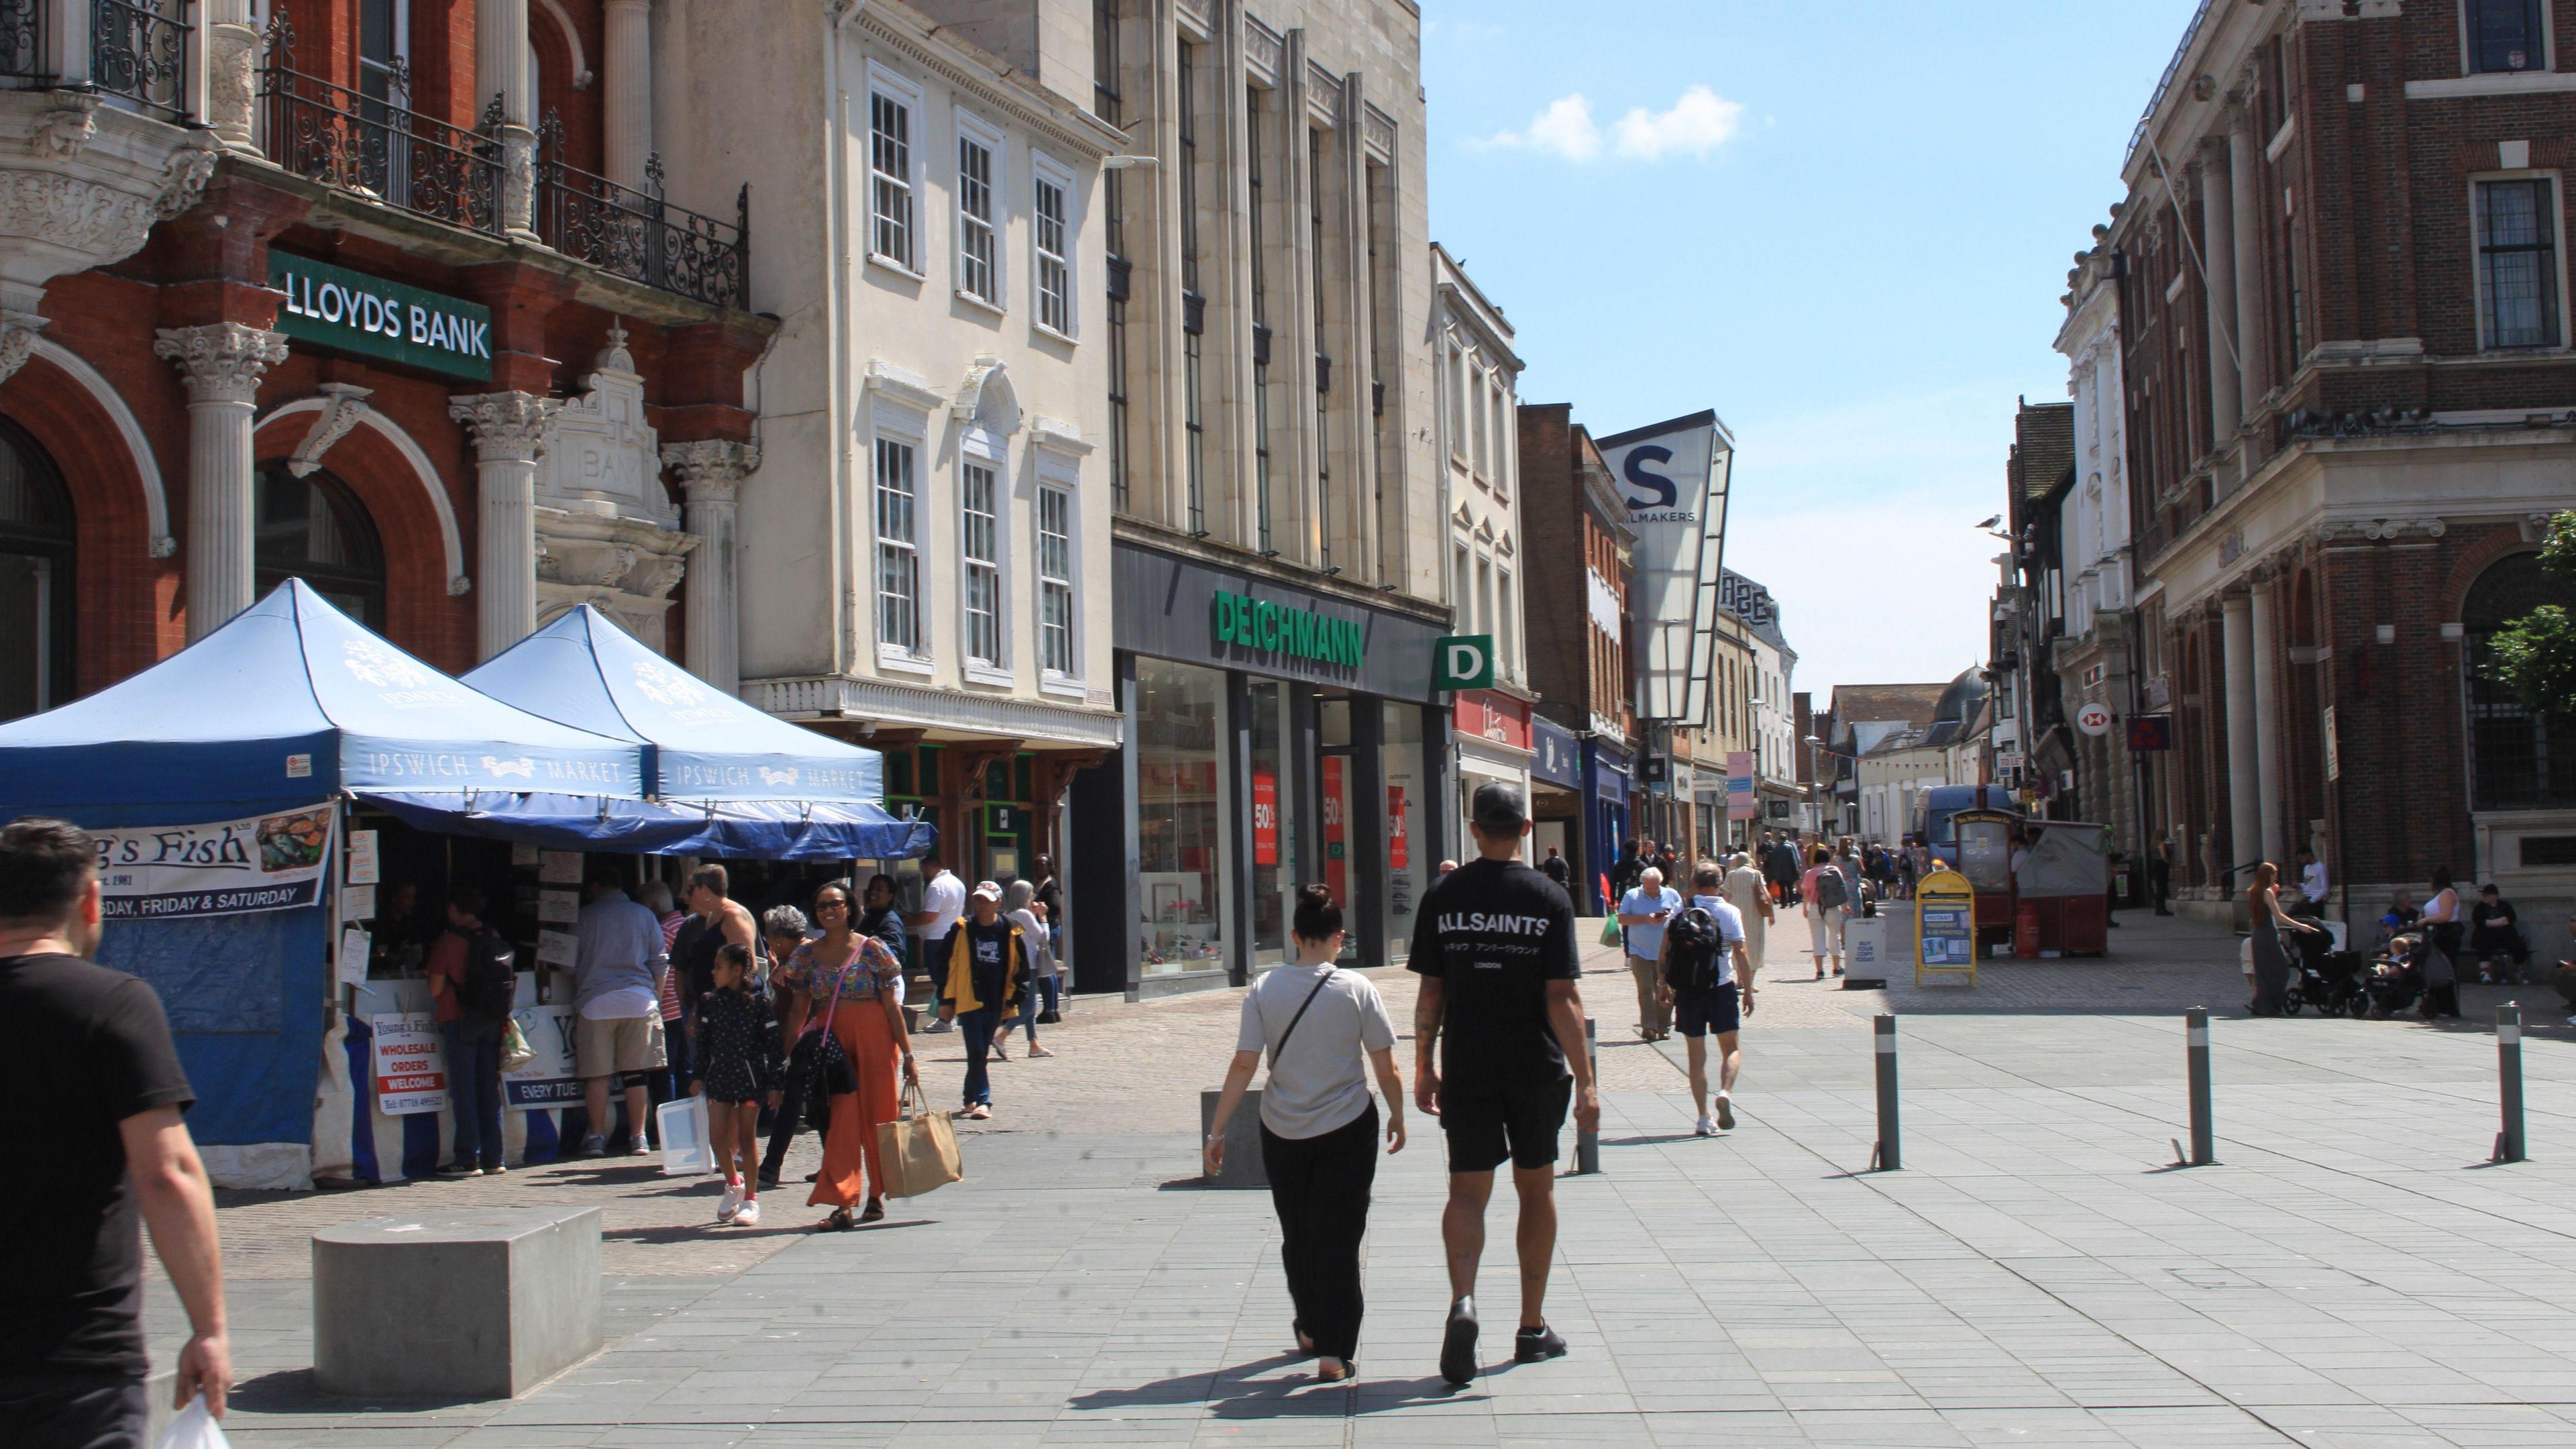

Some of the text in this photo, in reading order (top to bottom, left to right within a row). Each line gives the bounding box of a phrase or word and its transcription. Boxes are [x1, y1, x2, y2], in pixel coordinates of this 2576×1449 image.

[286, 272, 490, 359] LLOYDS BANK
[1623, 445, 1677, 510] S
[1214, 590, 1363, 668] DEICHMANN
[1448, 644, 1483, 680] D
[370, 752, 621, 784] IPSWICH MARKET
[676, 765, 864, 790] IPSWICH MARKET
[150, 826, 251, 864] Fish
[112, 874, 132, 885] 1981
[142, 896, 200, 914] FRIDAY
[201, 896, 213, 910] &
[217, 887, 297, 908] SATURDAY
[1438, 912, 1550, 936] ALLSAINTS
[376, 1021, 412, 1035] Young's
[380, 1043, 436, 1056] WHOLESALE
[392, 1060, 429, 1072] ORDERS
[387, 1077, 435, 1090] WELCOME
[521, 1084, 552, 1099] EVERY
